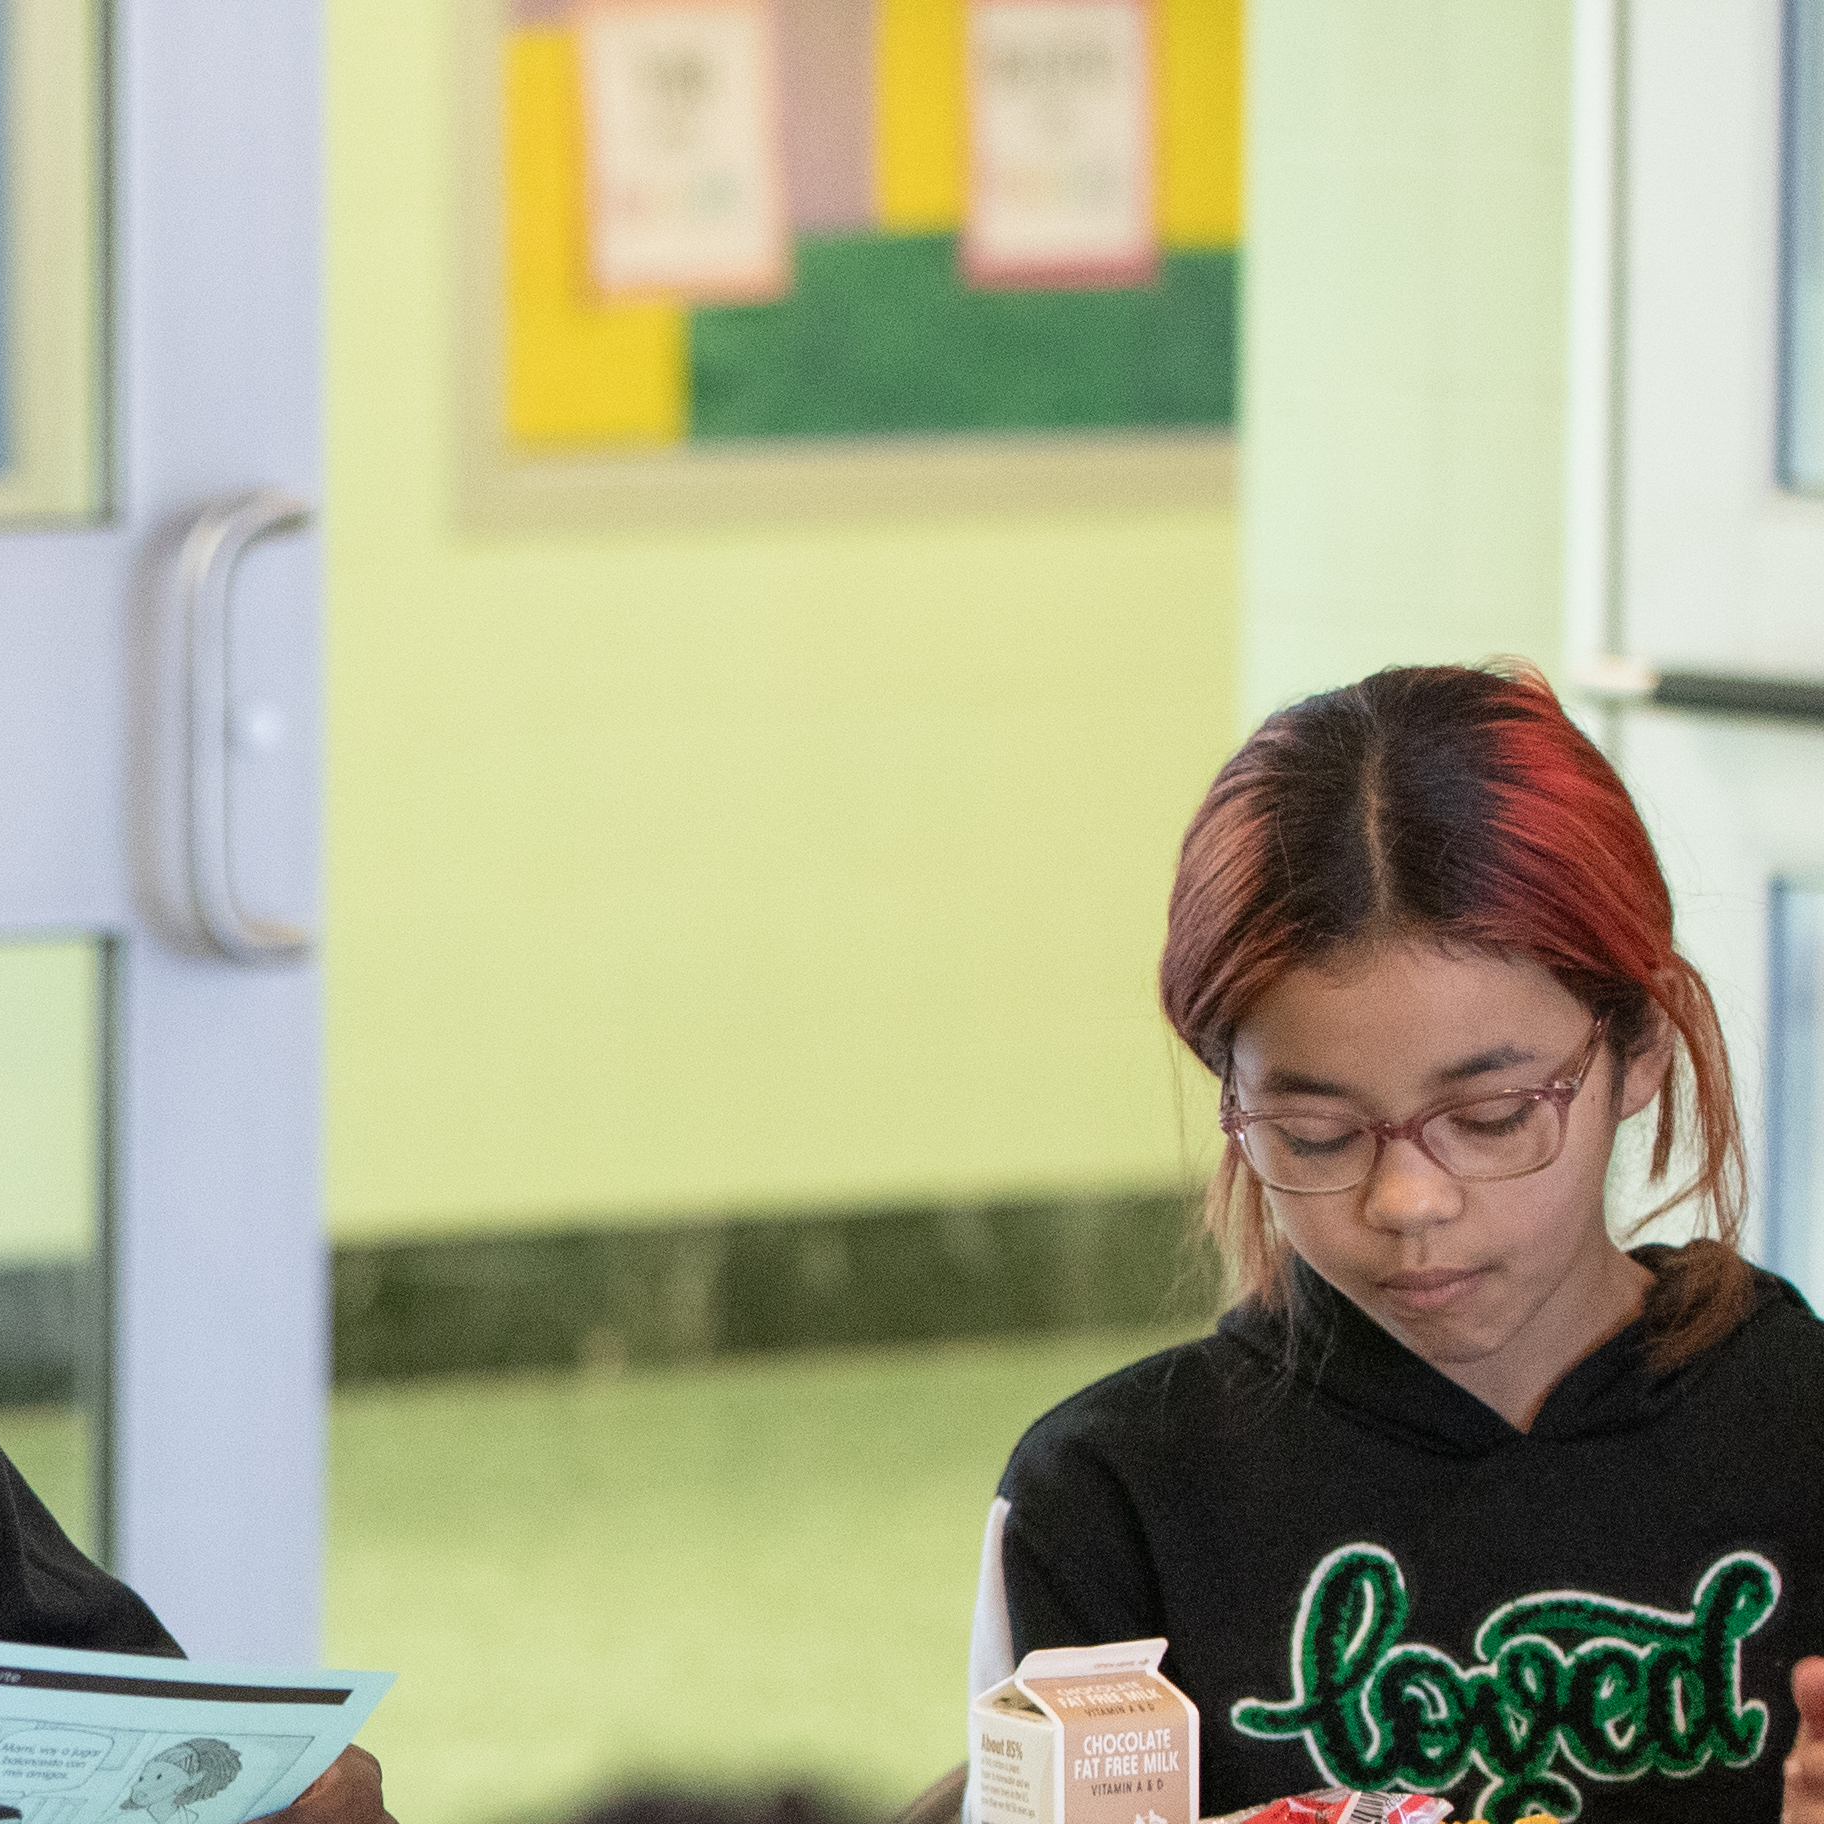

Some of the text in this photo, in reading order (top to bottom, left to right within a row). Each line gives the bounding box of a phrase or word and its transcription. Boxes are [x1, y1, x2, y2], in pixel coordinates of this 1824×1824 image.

[1058, 1688, 1163, 1708] FAT FREE MILK
[1085, 1705, 1126, 1718] VITAMIN
[1128, 1704, 1135, 1714] A
[981, 1733, 1024, 1761] About 85%
[1083, 1728, 1171, 1755] CHOCOLATE
[1074, 1751, 1180, 1780] FAT FREE MILK
[1091, 1781, 1132, 1796] VITAMIN
[1136, 1780, 1143, 1792] A
[1157, 1778, 1164, 1790] D
